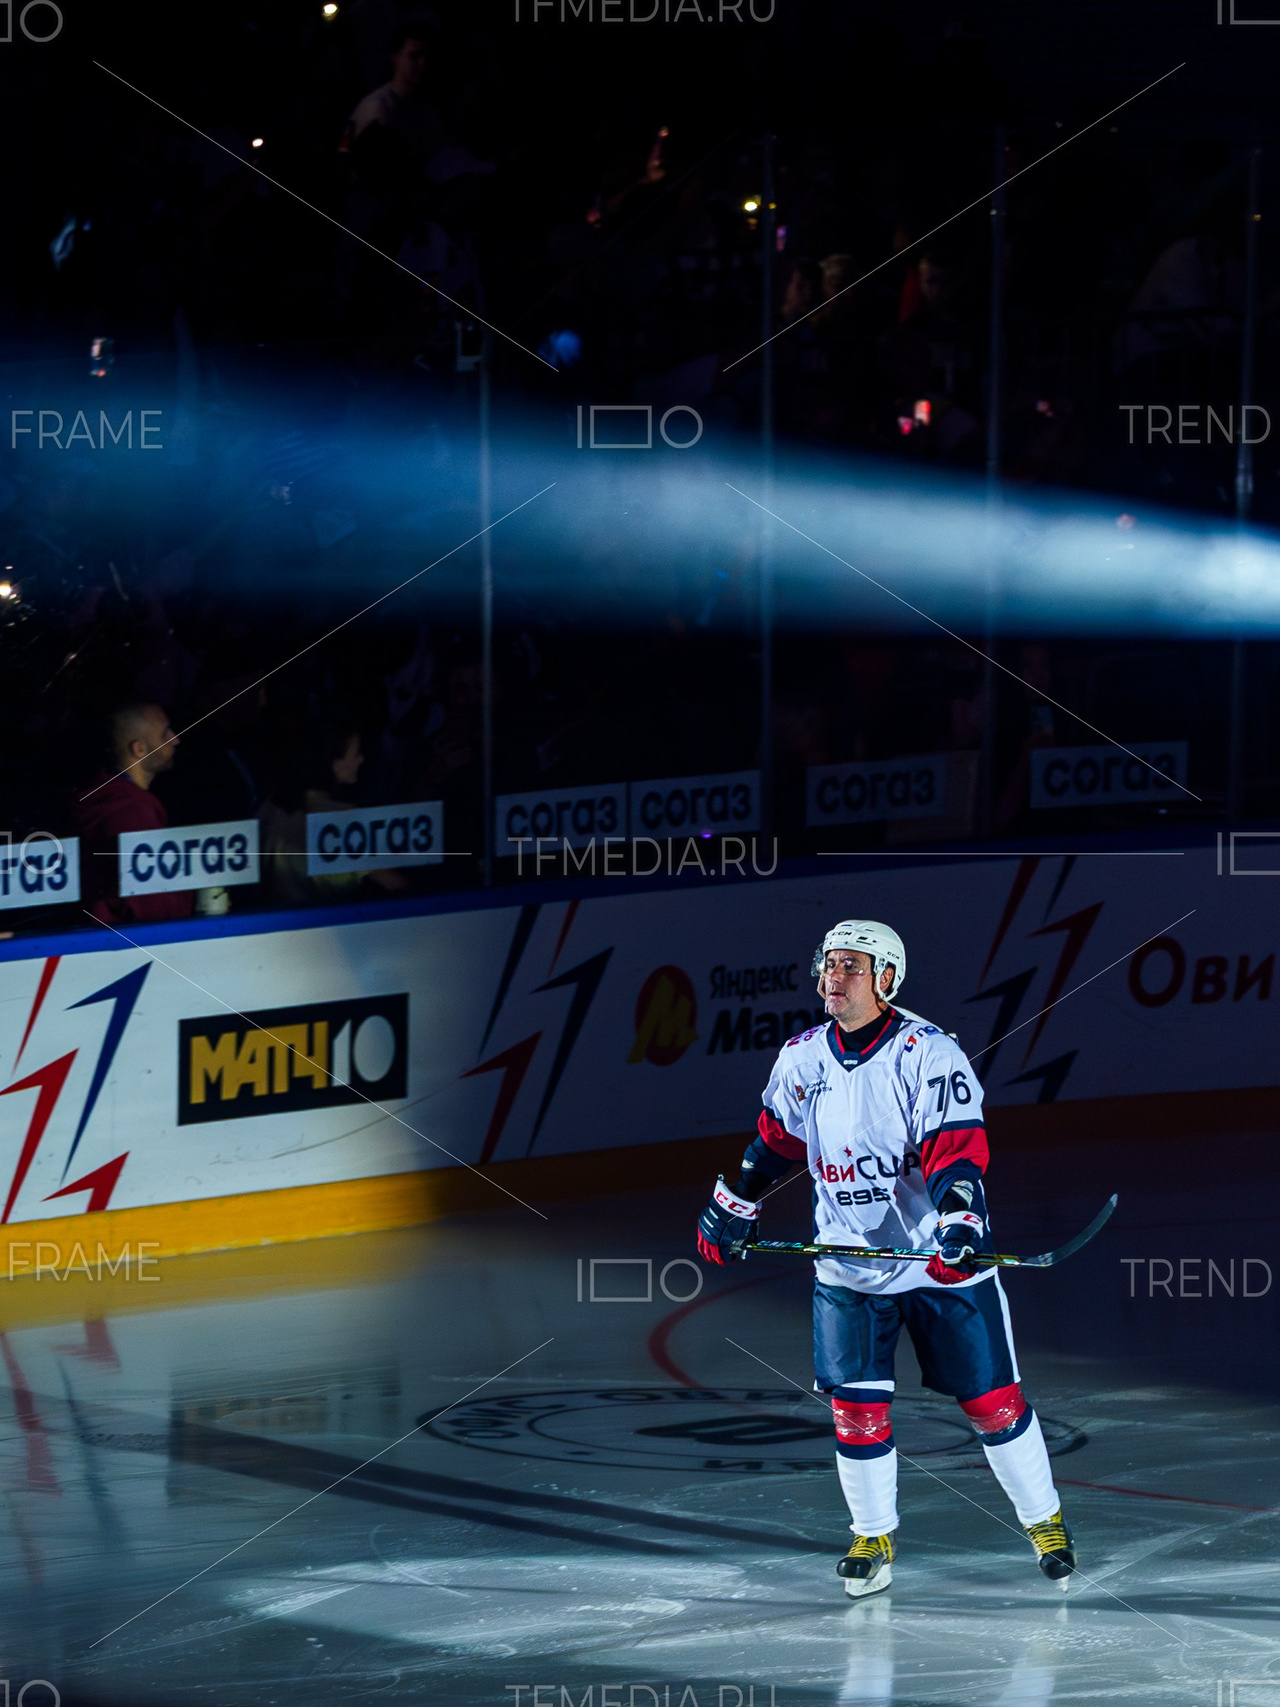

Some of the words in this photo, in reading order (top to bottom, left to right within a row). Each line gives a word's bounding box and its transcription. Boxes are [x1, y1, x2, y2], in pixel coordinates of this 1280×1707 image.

[1, 851, 69, 896] газ
[710, 963, 798, 1001] Яндекс
[706, 1007, 831, 1055] Мар
[927, 1071, 971, 1112] 76
[836, 1187, 891, 1206] 895
